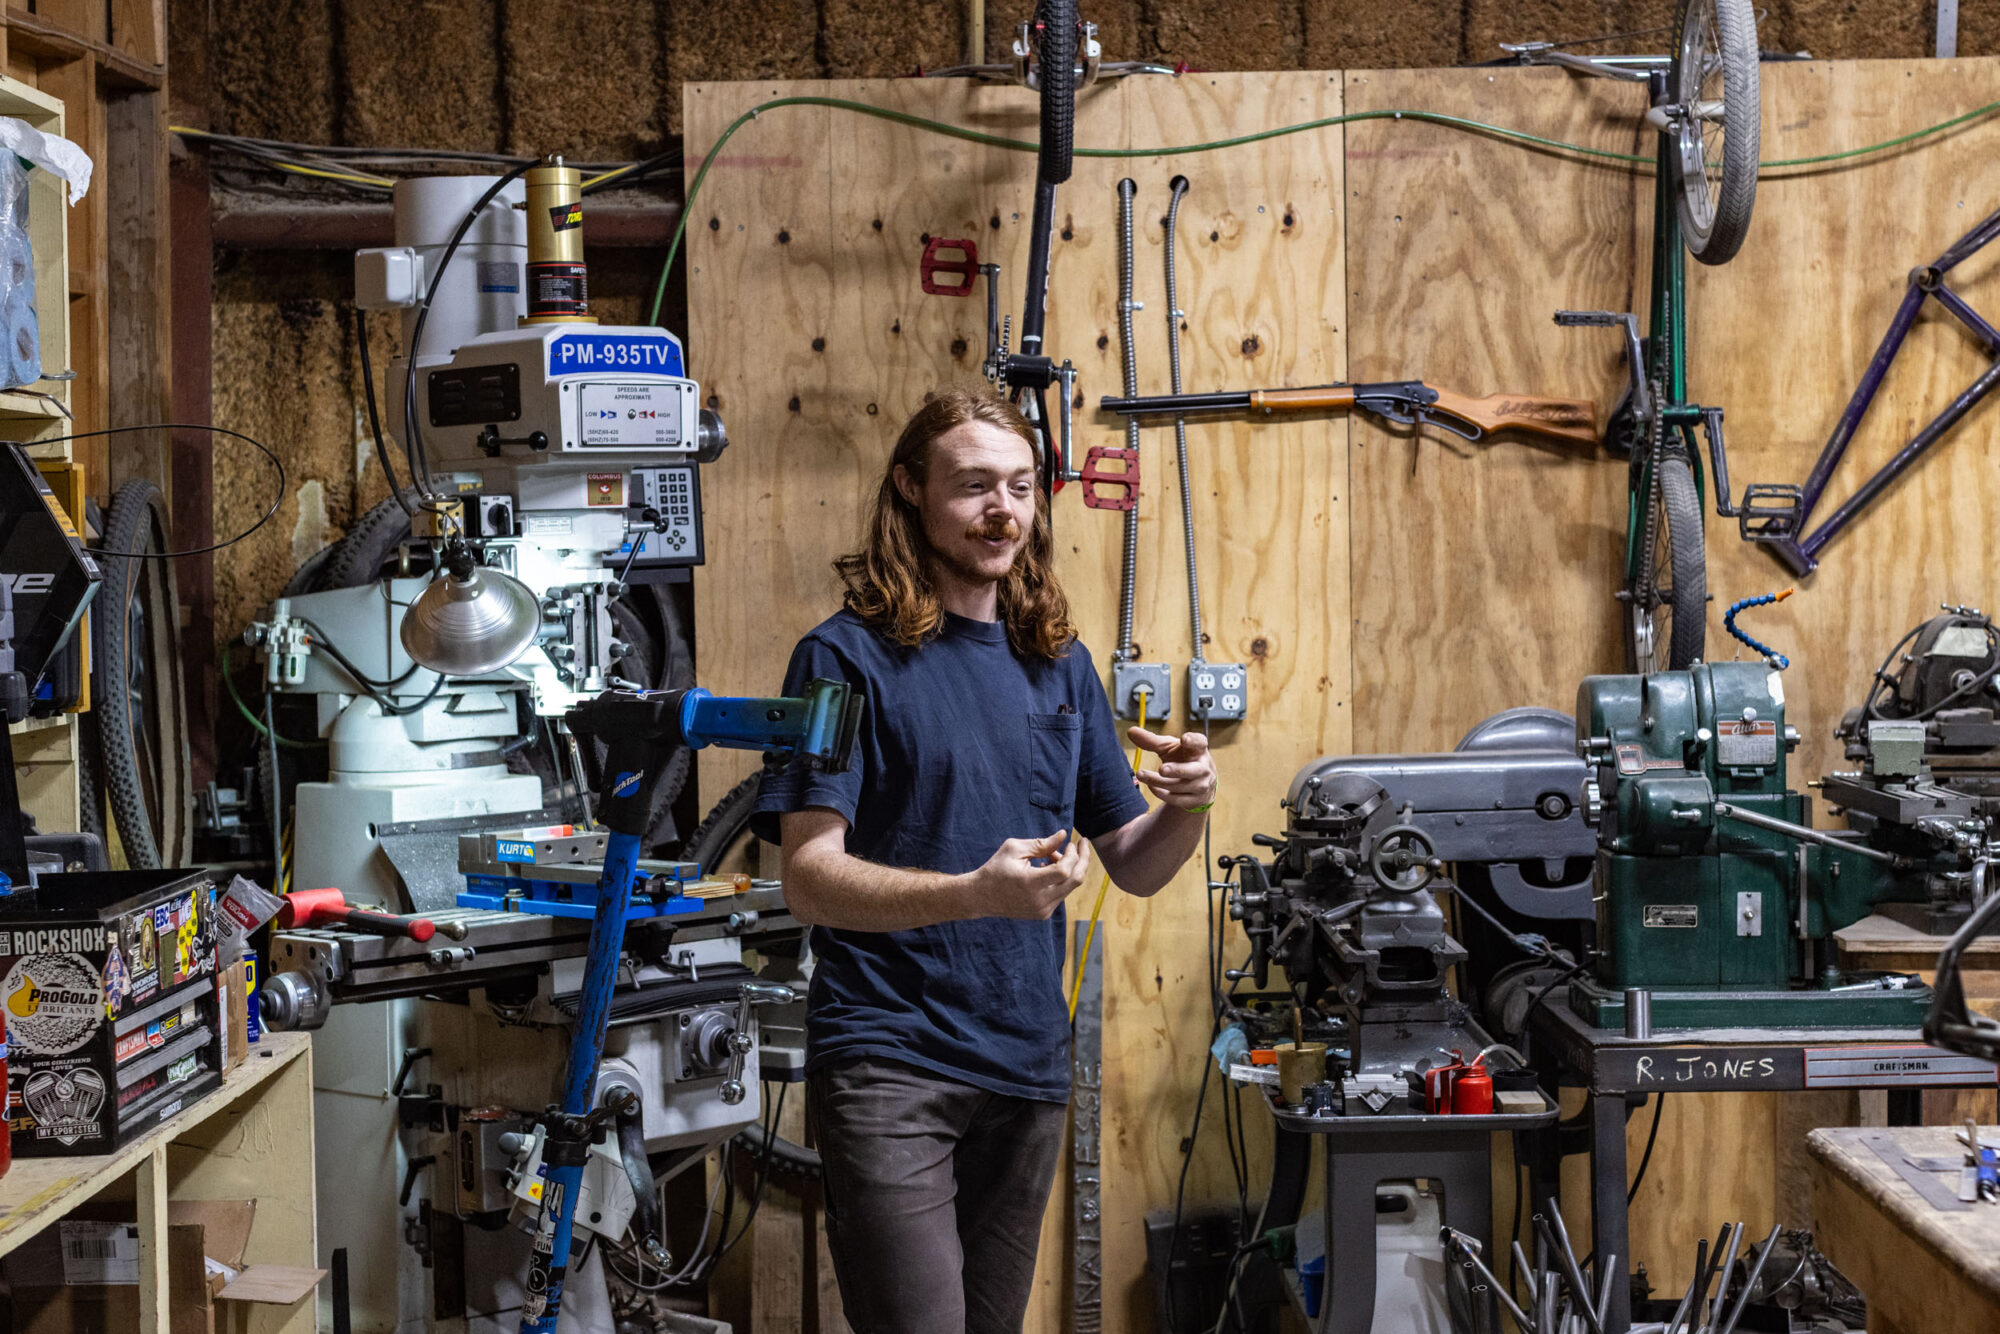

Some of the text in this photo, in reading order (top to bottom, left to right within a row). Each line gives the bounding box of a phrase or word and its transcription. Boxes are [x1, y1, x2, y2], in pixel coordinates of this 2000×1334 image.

[561, 343, 669, 365] PM-935TV
[498, 843, 524, 855] KURT
[155, 906, 169, 929] EBC
[14, 928, 105, 955] ROCKSHOX
[51, 1057, 92, 1066] GIRLFRIEND
[1636, 1056, 1776, 1085] R. JONES
[39, 1124, 97, 1136] MY SPORTSTER
